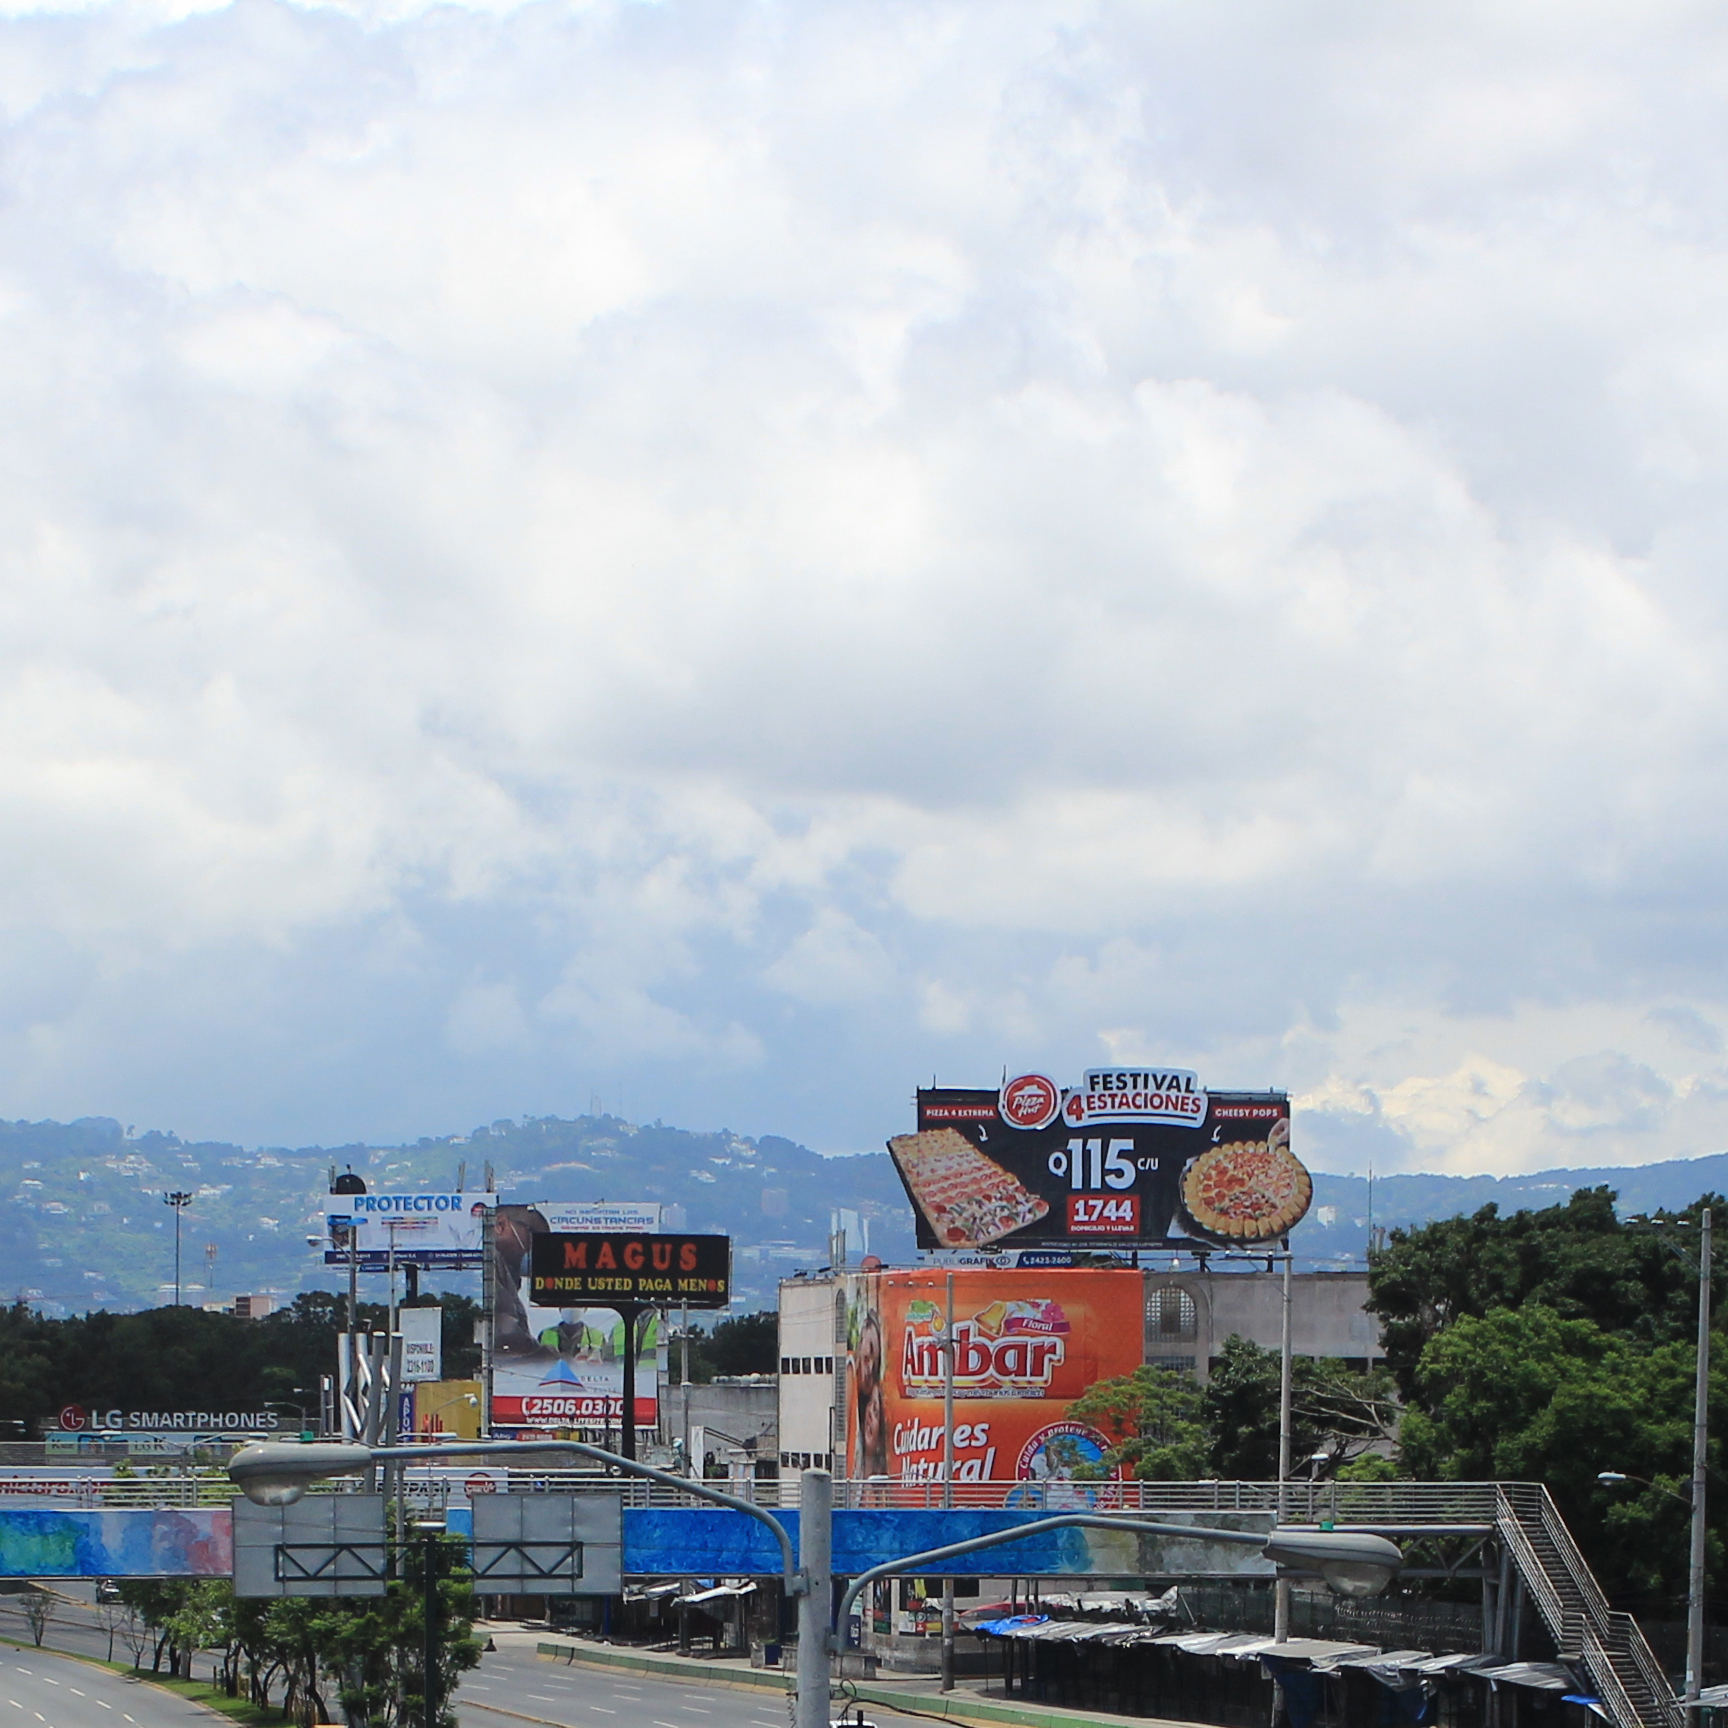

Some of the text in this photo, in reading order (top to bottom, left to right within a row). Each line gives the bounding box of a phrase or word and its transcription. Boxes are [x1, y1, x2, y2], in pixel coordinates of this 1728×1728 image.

[1089, 1073, 1195, 1094] FESTIVAL
[1013, 1093, 1046, 1110] Pizza
[1066, 1093, 1202, 1121] 4 ESTACIONES
[926, 1109, 949, 1117] PIZZA
[958, 1109, 995, 1117] EXTREMA
[1018, 1105, 1040, 1118] Hut
[1215, 1108, 1278, 1117] CHEESY POPS
[1137, 1157, 1159, 1171] C/U
[354, 1195, 463, 1212] PROTECTOR
[1073, 1199, 1134, 1222] 1744
[549, 1216, 654, 1225] CIRCUNSTANCIAS
[563, 1242, 697, 1271] MAGUS
[535, 1277, 725, 1292] DONDE USTED PAGA MENOS
[1022, 1318, 1053, 1331] Floral
[905, 1326, 1058, 1377] Ambar
[92, 1410, 279, 1429] LG SMARTPHONES
[893, 1417, 990, 1455] Cuidar es
[902, 1447, 996, 1488] Natural
